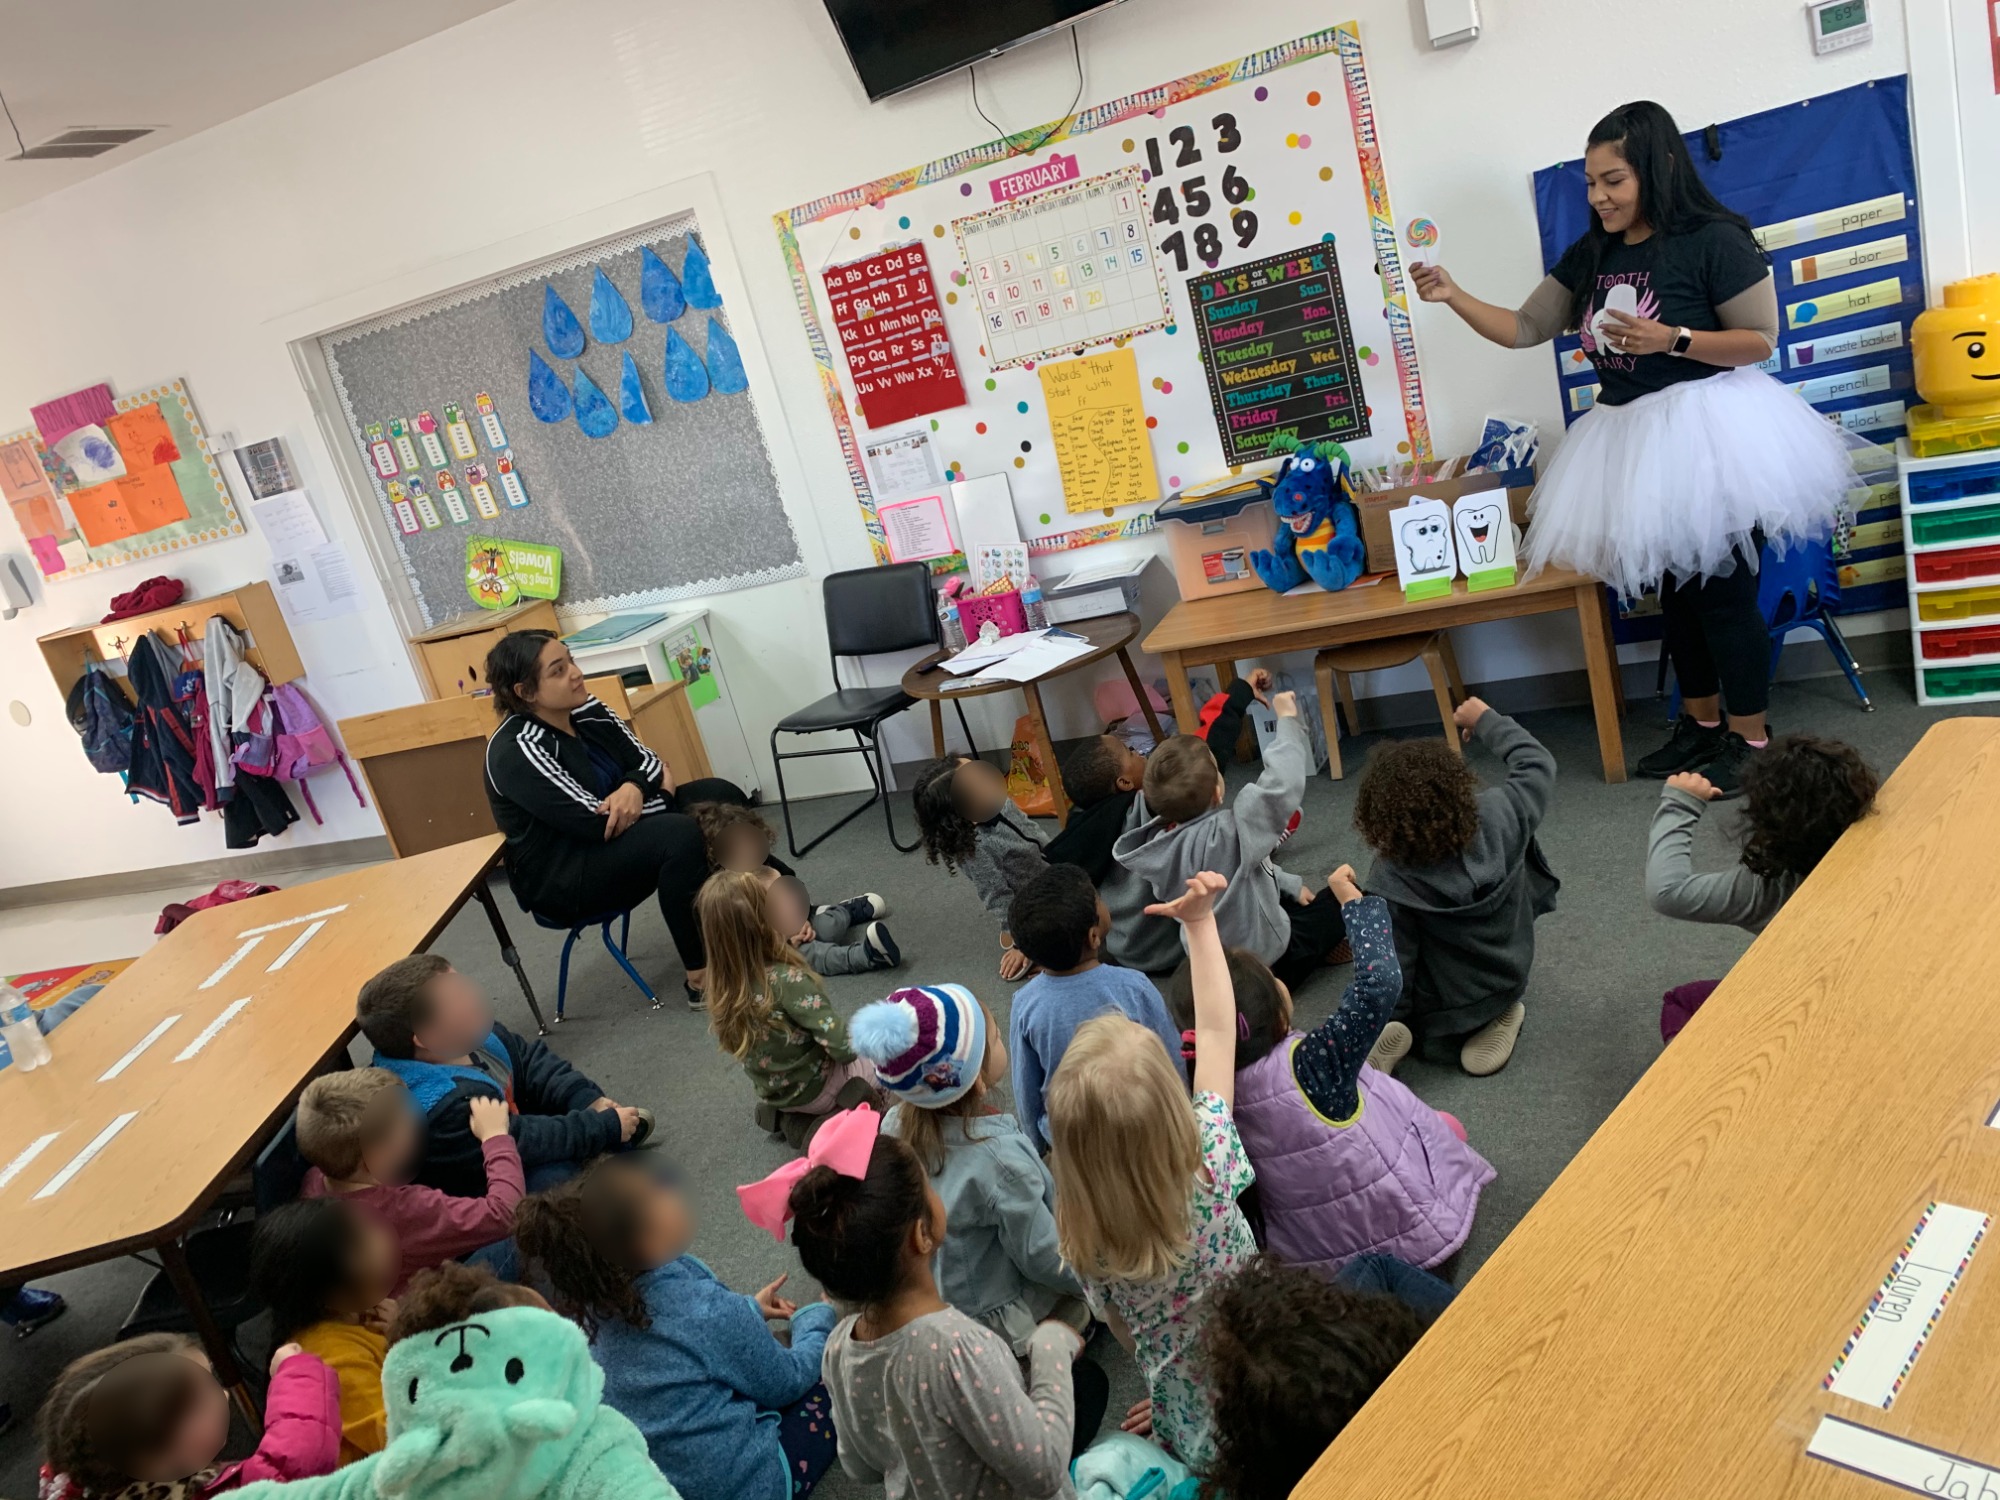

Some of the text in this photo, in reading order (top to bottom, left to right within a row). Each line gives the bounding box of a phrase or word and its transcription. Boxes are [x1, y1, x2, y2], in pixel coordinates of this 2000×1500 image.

[1146, 113, 1241, 177] 1 2 3
[1000, 161, 1068, 198] FEBRUARY
[1153, 164, 1249, 225] 4 5 6
[963, 222, 984, 236] SUNDAY
[986, 216, 1008, 230] MONDAY
[1009, 208, 1032, 223] TUESDAY
[1085, 186, 1105, 200] FRIDAY
[1108, 177, 1134, 192] SATURDAY
[1122, 196, 1128, 210] 1
[1842, 208, 1883, 231] paper
[980, 224, 1135, 280] 2 3 4 5 6 7 8
[1161, 210, 1258, 272] 7 8 9
[1849, 251, 1882, 266] door
[827, 252, 922, 289] Aa Bb Cc Dd Ee
[988, 248, 1143, 304] 9 10 11 12 13 14 15
[1200, 254, 1326, 301] DAYS OF THE WEEK
[1596, 272, 1650, 290] TOOTH
[836, 302, 848, 316] Ff
[873, 290, 891, 306] Hh
[895, 283, 908, 298] Ii
[918, 278, 928, 294] Jj
[990, 290, 1102, 329] 16 17 18 19 20
[1208, 284, 1327, 321] Sunday Sun.
[1848, 292, 1872, 308] hat
[841, 309, 939, 342] Kk Ll Mm Nn Oo
[1212, 306, 1331, 343] Monday Mon.
[850, 356, 866, 368] Pp
[868, 350, 887, 362] Qq
[891, 344, 904, 357] Rr
[911, 339, 925, 351] Ss
[1217, 328, 1335, 364] Tuesday Tues.
[1824, 331, 1897, 356] waste basket
[856, 356, 944, 394] Uu Vv Ww Xx Yy
[944, 368, 957, 378] Zz
[1046, 361, 1114, 384] Words that
[1221, 350, 1340, 386] Wednesday Wed.
[1594, 357, 1637, 372] FAIRY
[1086, 379, 1112, 392] with
[1226, 372, 1344, 408] Thursday Thurs.
[1830, 378, 1870, 398] pencil
[1231, 391, 1348, 428] Friday Fri.
[1328, 414, 1352, 430] Sat.
[1847, 411, 1882, 429] clock
[509, 550, 554, 574] Vowels
[1874, 1262, 1952, 1323] Lauren
